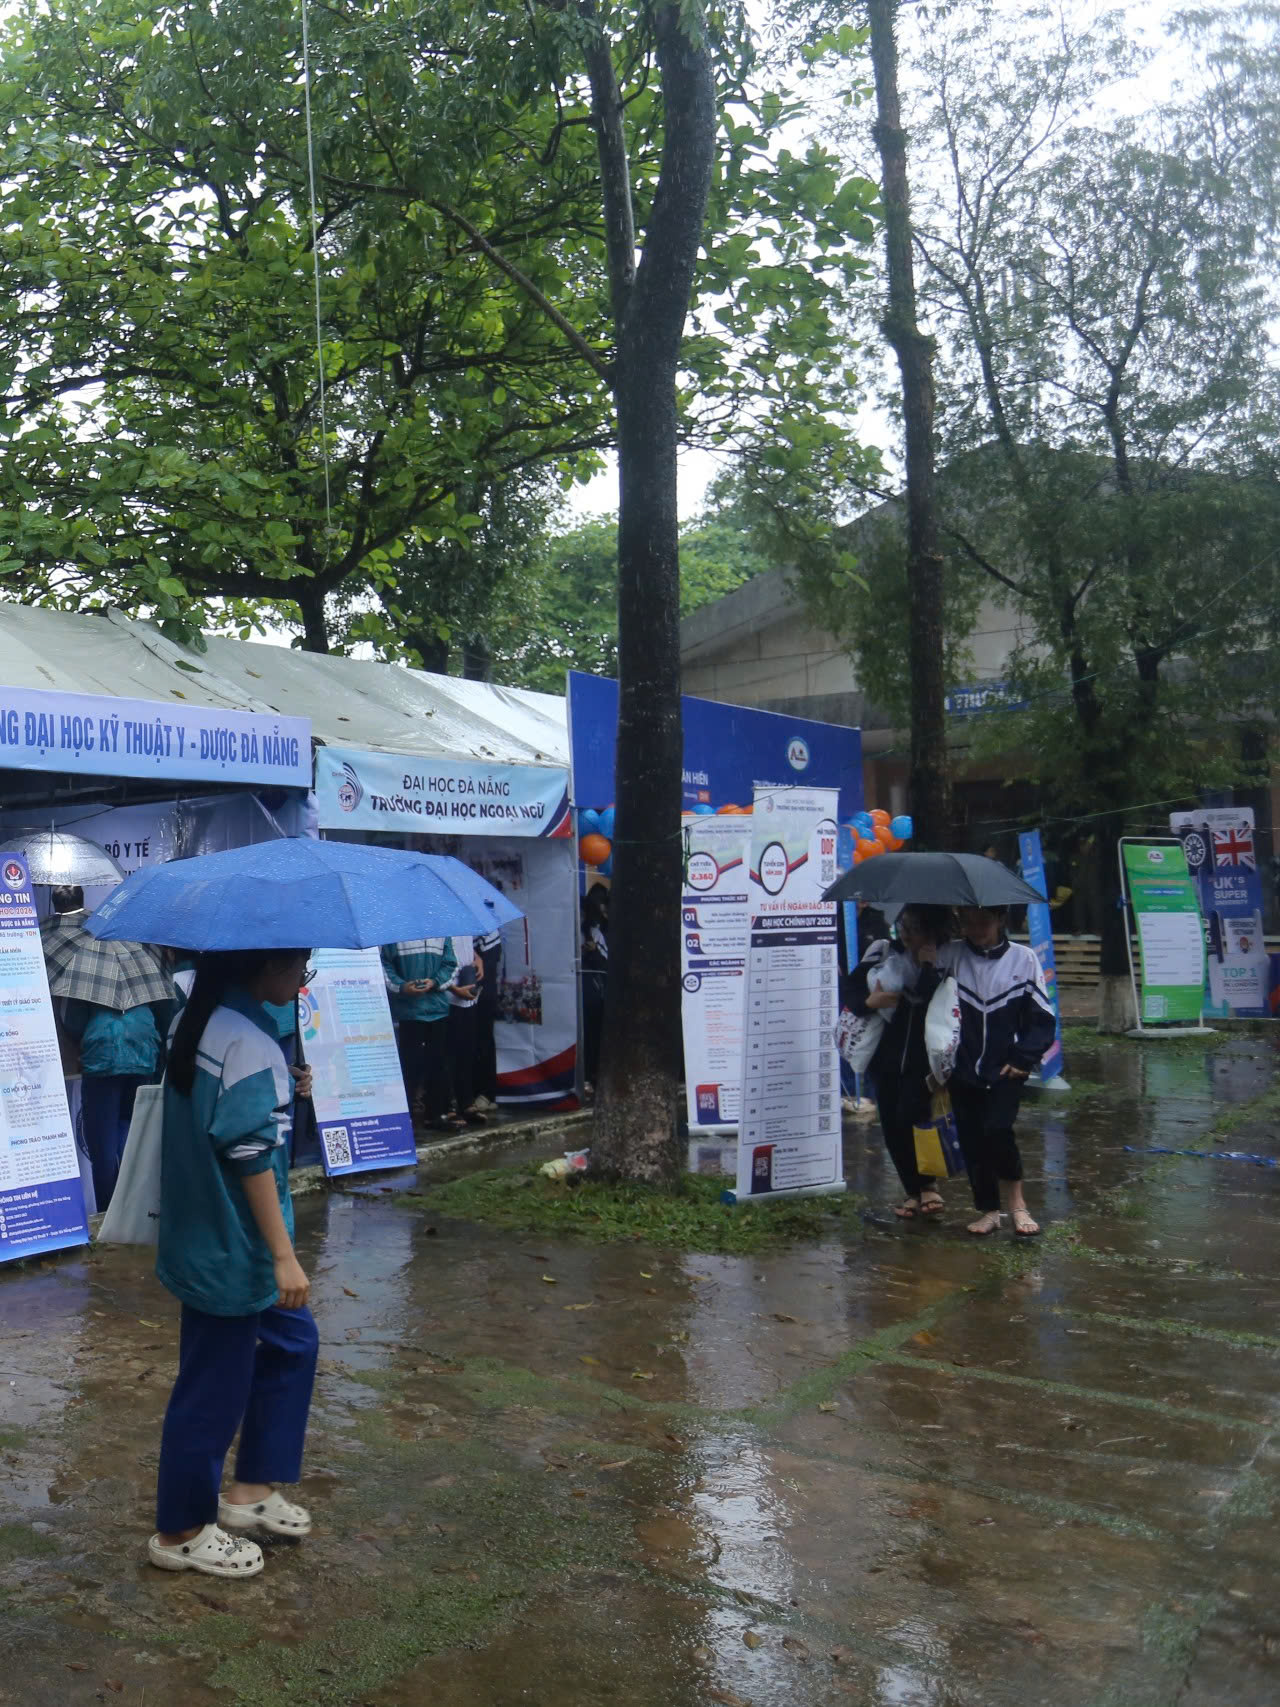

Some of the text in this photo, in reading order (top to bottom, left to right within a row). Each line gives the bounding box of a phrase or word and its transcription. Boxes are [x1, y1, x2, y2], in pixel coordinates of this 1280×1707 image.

[24, 711, 55, 755] ĐẠI
[60, 715, 94, 758] HỌC
[99, 713, 120, 753] KỸ
[124, 717, 172, 763] THUẬT
[177, 726, 185, 757] Y
[200, 728, 237, 768] DƯỢC
[241, 728, 259, 764] ĐÀ
[263, 725, 299, 767] NẴNG
[403, 774, 510, 797] ĐẠI HỌC ĐÀ NẴNG
[371, 793, 545, 822] TRƯỜNG ĐẠI HỌC NGOẠI NGỮ
[124, 843, 131, 858] Y
[135, 836, 151, 857] TẾ
[15, 893, 30, 903] TIN
[1214, 890, 1248, 899] SUPER
[16, 906, 33, 915] 2026
[684, 913, 695, 921] 01
[687, 939, 699, 948] 02
[1222, 967, 1246, 977] TOP
